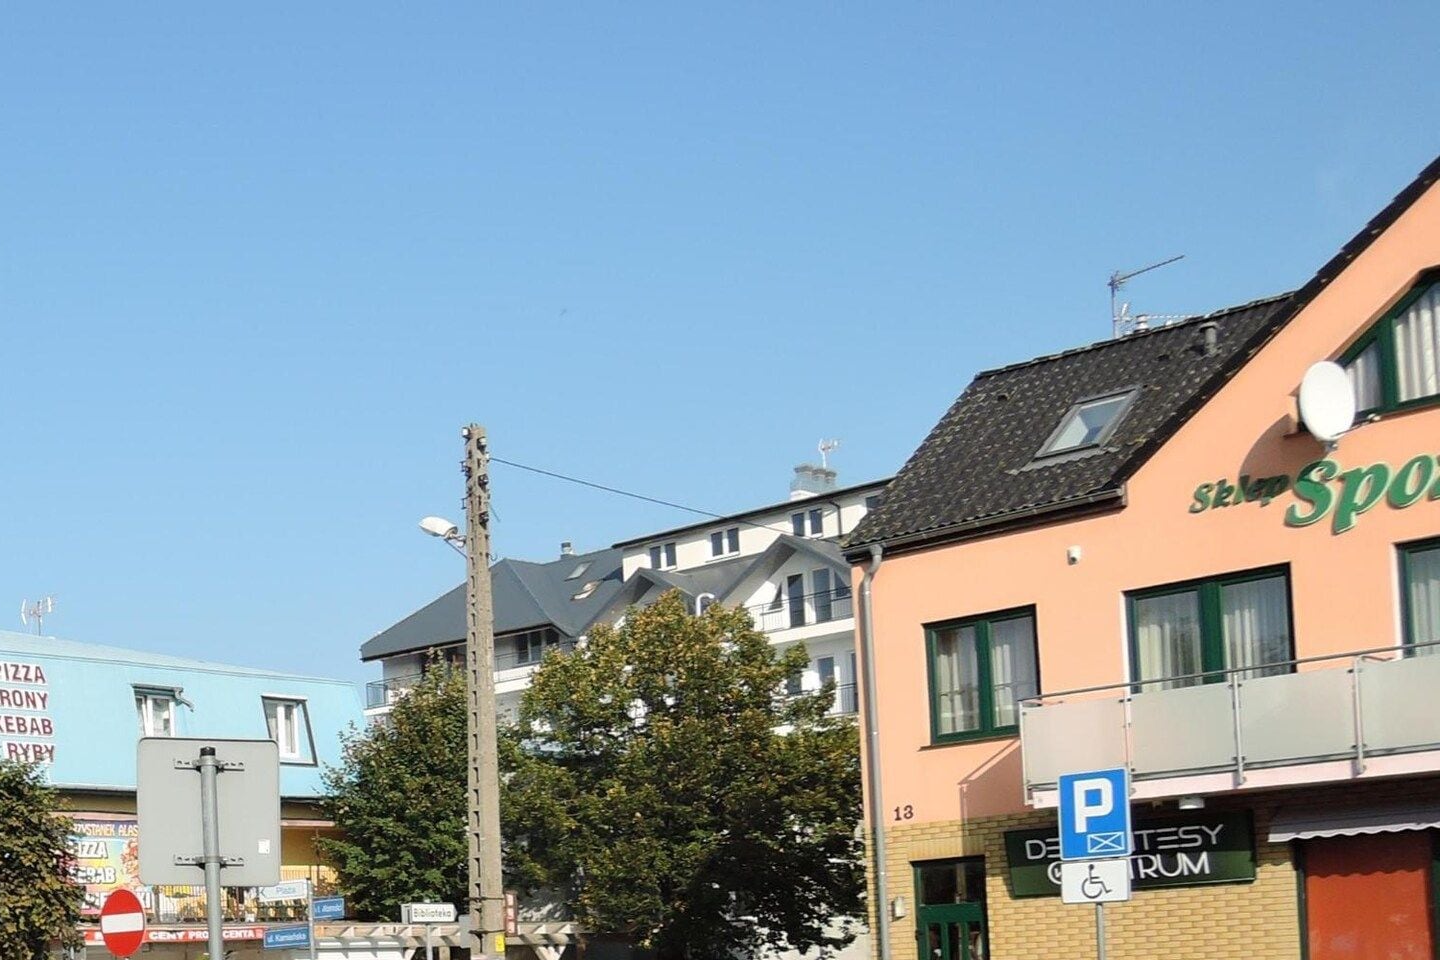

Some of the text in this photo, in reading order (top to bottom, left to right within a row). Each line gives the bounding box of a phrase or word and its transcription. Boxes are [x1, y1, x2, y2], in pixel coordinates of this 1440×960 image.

[893, 804, 914, 821] 13
[1073, 777, 1114, 833] P
[73, 823, 138, 837] ZYSTANEK ALAS
[1025, 823, 1224, 860] DETESY
[1047, 851, 1211, 885] CTRUM
[413, 908, 452, 918] Biblioteka
[189, 930, 254, 940] PROCENTA
